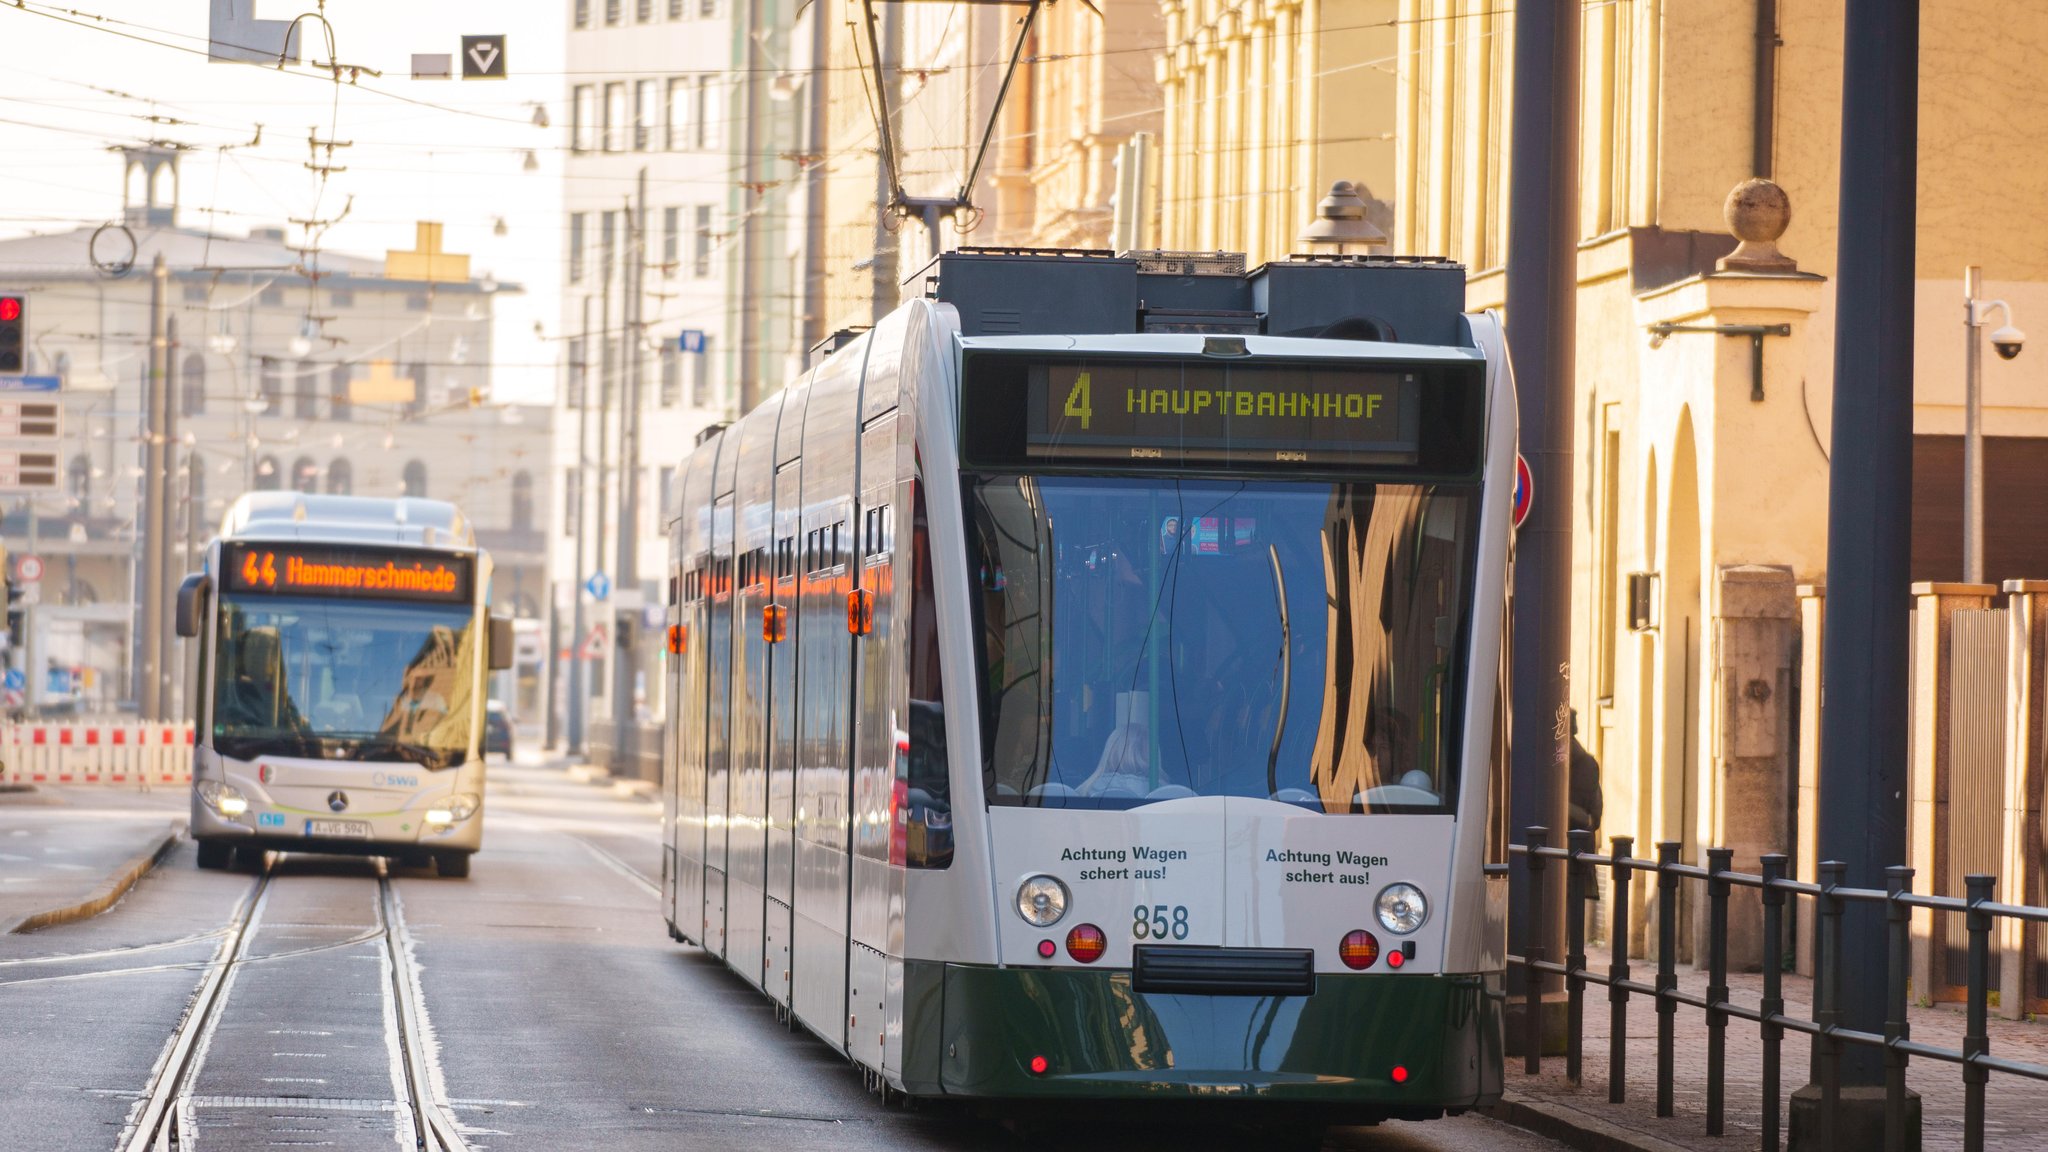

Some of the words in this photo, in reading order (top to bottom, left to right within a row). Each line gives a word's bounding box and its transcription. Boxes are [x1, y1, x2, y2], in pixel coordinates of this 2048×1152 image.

[1064, 372, 1092, 430] 4
[1127, 388, 1382, 418] HAUPTBAHNHOF
[242, 551, 277, 586] 44
[286, 556, 456, 592] Hammerschmiede
[1061, 847, 1126, 863] Achtung
[1132, 846, 1187, 863] Wagen
[1265, 848, 1331, 866] Achtung
[1336, 850, 1388, 869] Wagen
[1080, 866, 1129, 880] schert
[1134, 866, 1166, 880] aus!
[1285, 869, 1334, 883] schert
[1339, 871, 1369, 885] aus!
[1132, 904, 1189, 941] 858
